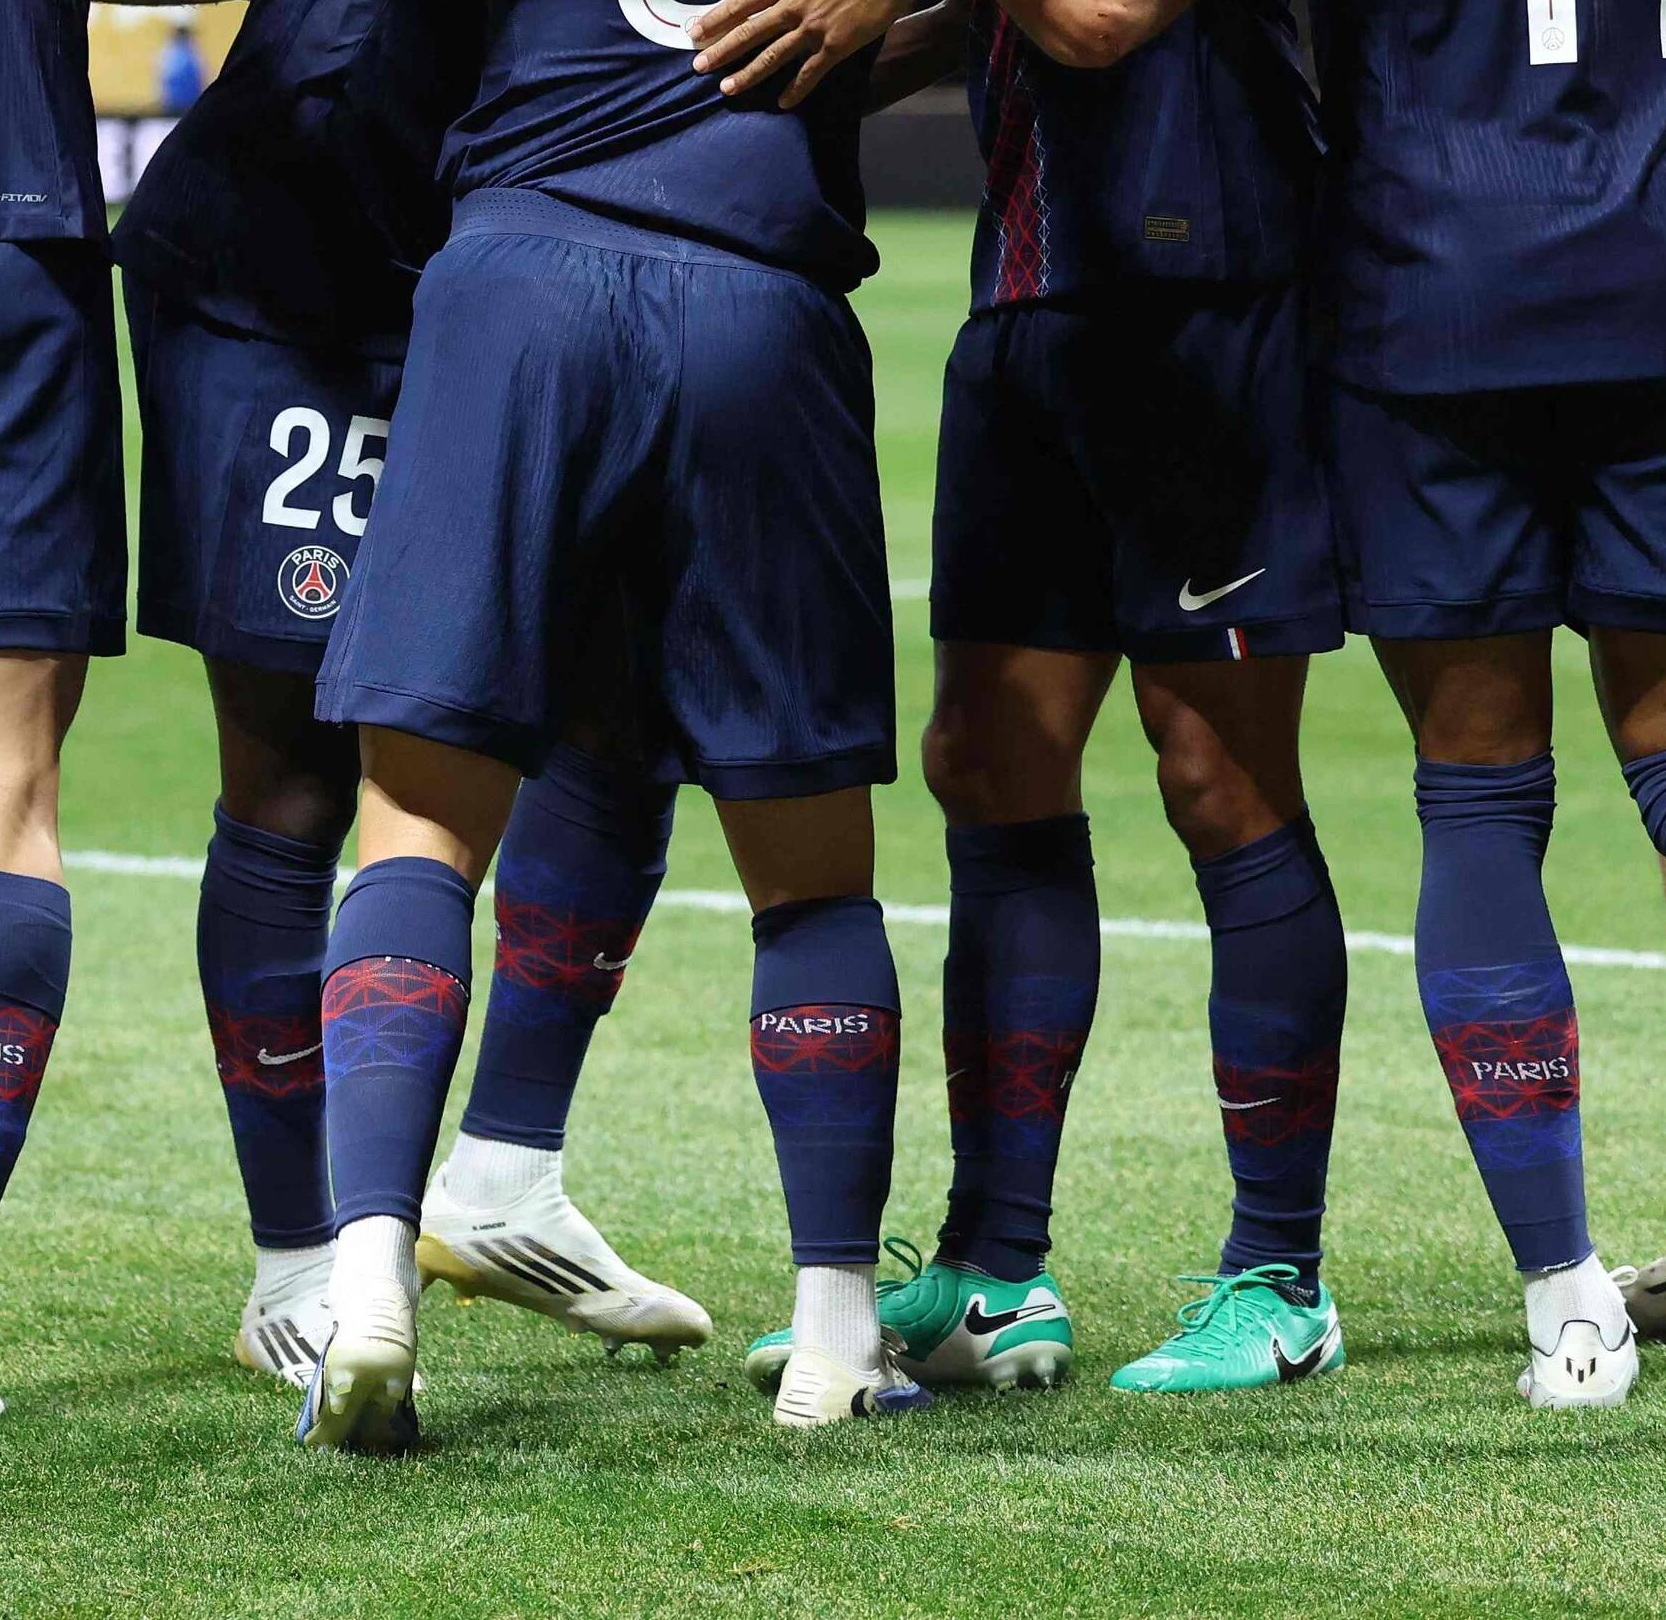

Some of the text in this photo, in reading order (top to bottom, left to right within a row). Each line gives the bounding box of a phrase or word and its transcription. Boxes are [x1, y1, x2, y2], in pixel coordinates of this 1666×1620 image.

[262, 406, 391, 537] 25
[291, 548, 340, 569] PARIS
[760, 1012, 869, 1035] PARIS
[1471, 1055, 1570, 1081] PARIS
